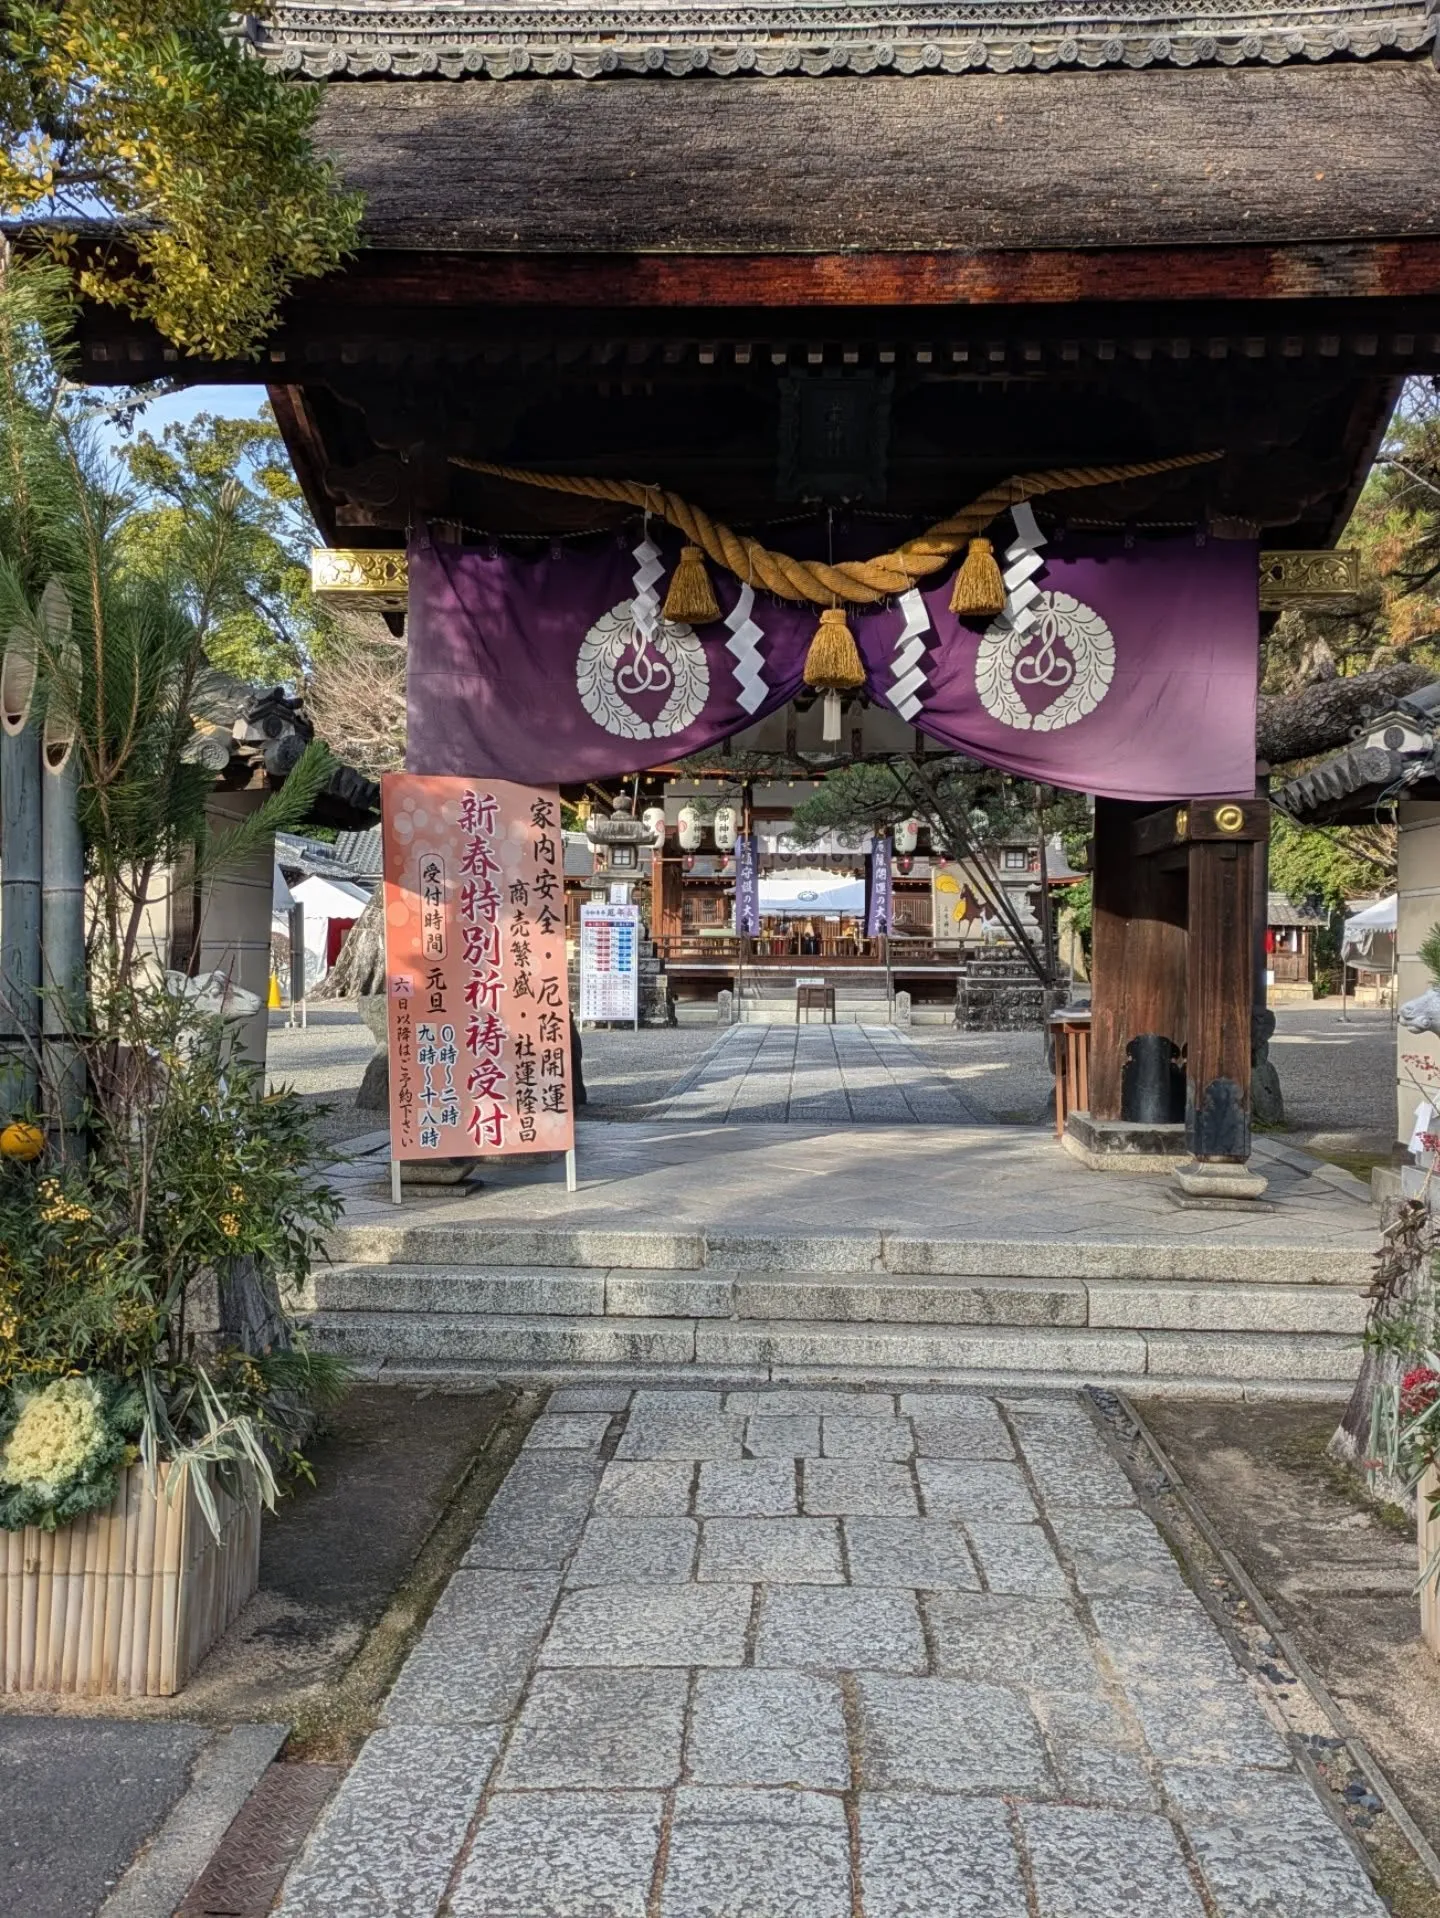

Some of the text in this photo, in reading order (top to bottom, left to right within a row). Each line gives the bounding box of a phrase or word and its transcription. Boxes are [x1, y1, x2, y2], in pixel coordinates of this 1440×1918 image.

[423, 862, 444, 954] 受付時間
[425, 967, 447, 1014] 元旦
[457, 789, 508, 1149] 新春特別祈祷受付
